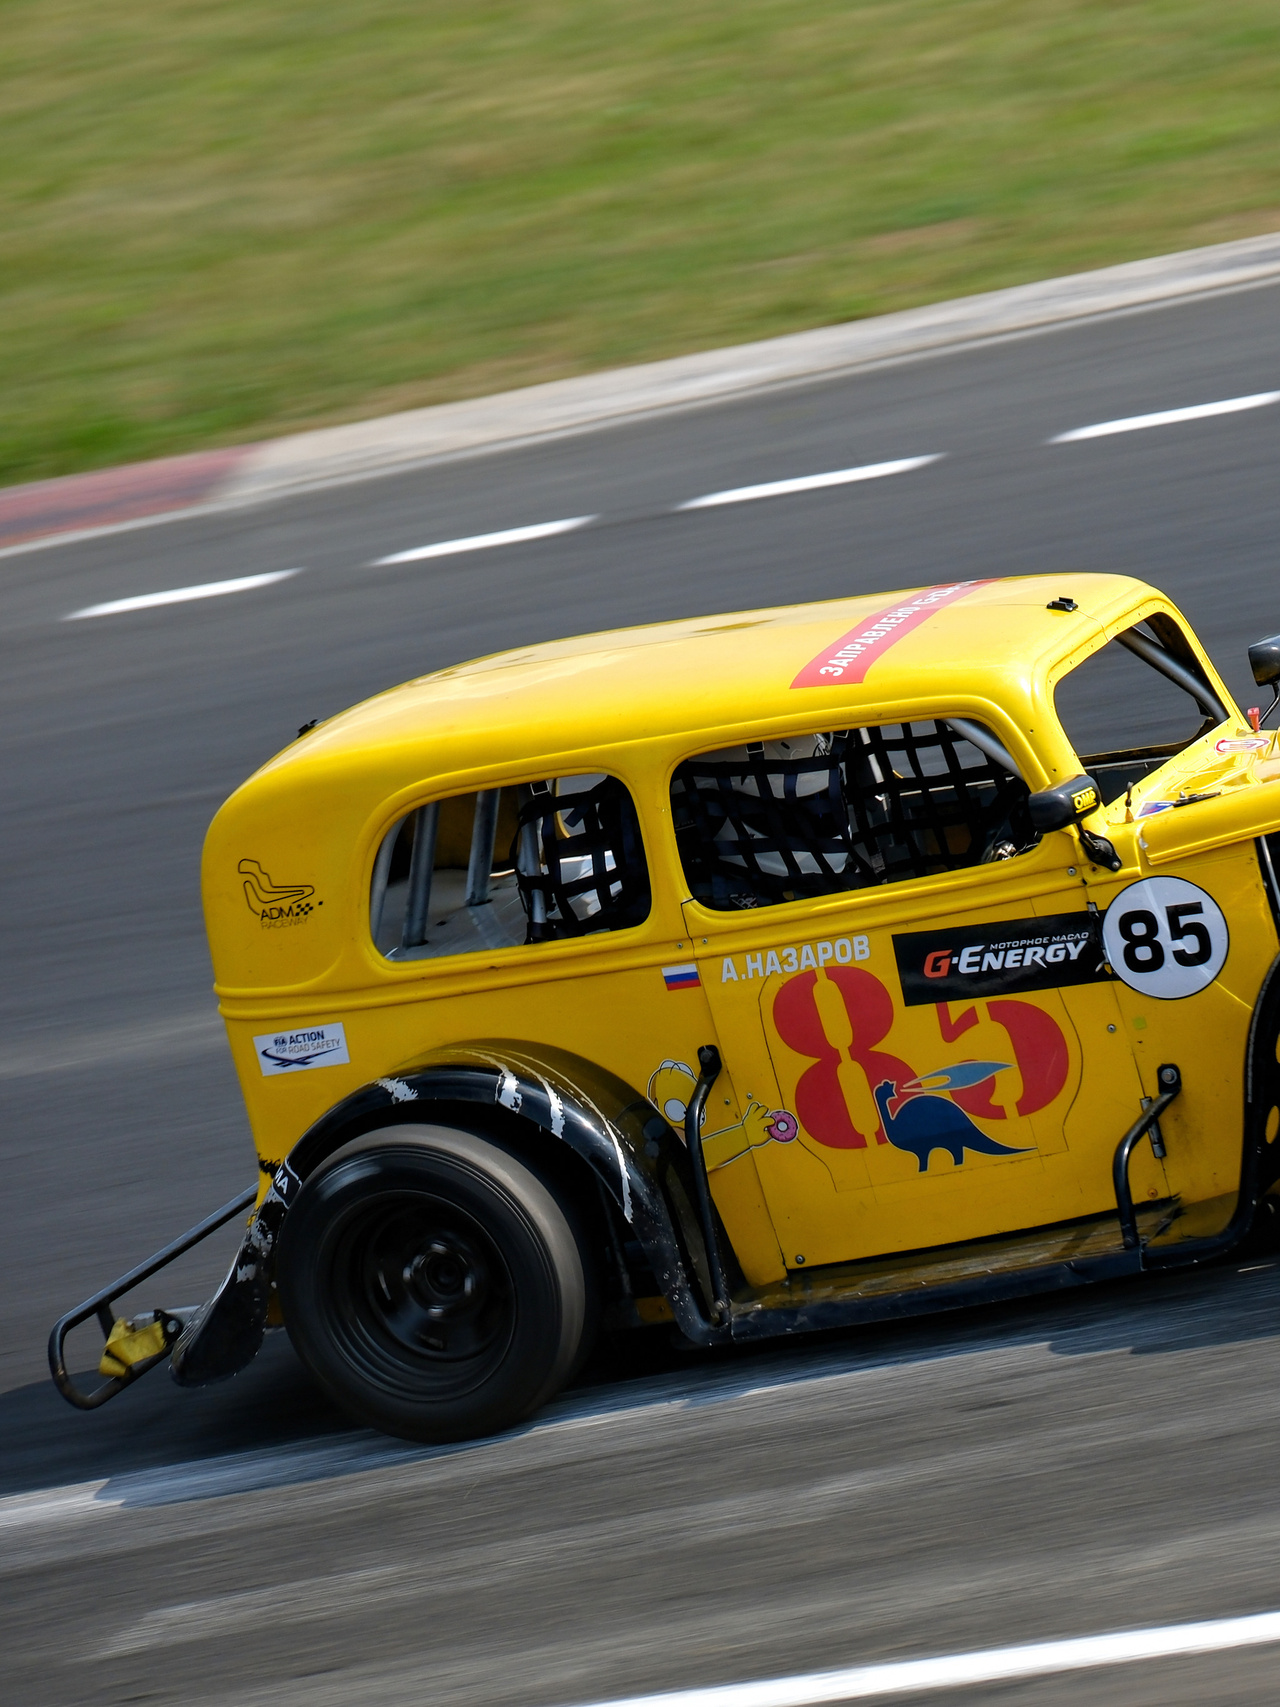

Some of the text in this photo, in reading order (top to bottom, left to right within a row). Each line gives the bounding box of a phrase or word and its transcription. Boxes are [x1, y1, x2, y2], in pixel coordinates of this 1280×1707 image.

[819, 606, 921, 677] ЗАПРАВЛЕНО
[1073, 789, 1097, 810] OMP
[260, 916, 309, 930] RACEWAY
[261, 905, 295, 921] ADM
[989, 931, 1090, 951] МОТОРНОЕ МАСЛО
[1118, 901, 1212, 974] 85
[721, 934, 871, 983] А.НАЗАРОВ
[275, 1037, 341, 1055] FOR ROAD SAFETY
[289, 1029, 325, 1045] ACTION
[772, 965, 1070, 1150] 85
